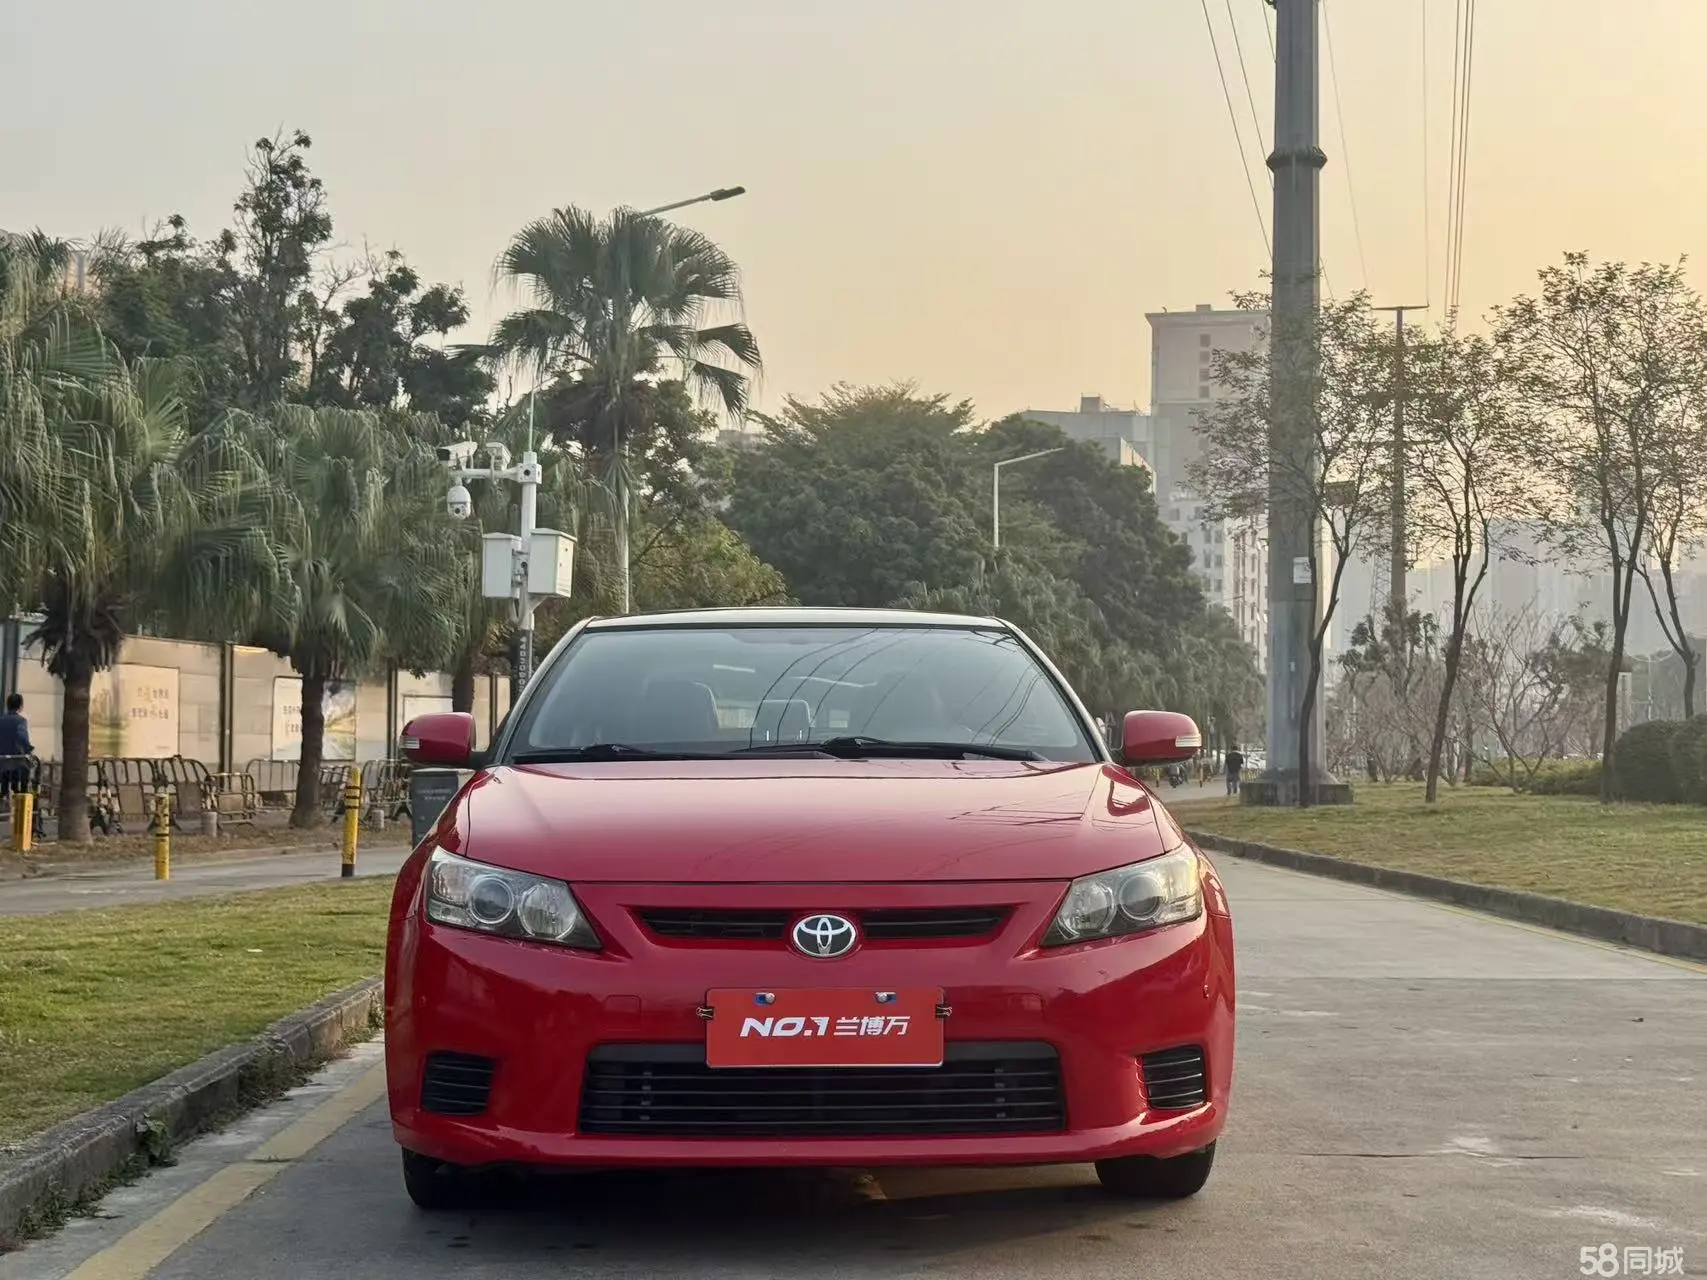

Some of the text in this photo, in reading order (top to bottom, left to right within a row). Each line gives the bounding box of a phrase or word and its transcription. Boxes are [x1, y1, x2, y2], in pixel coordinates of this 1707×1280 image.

[740, 1015, 911, 1037] NO.1 兰博万
